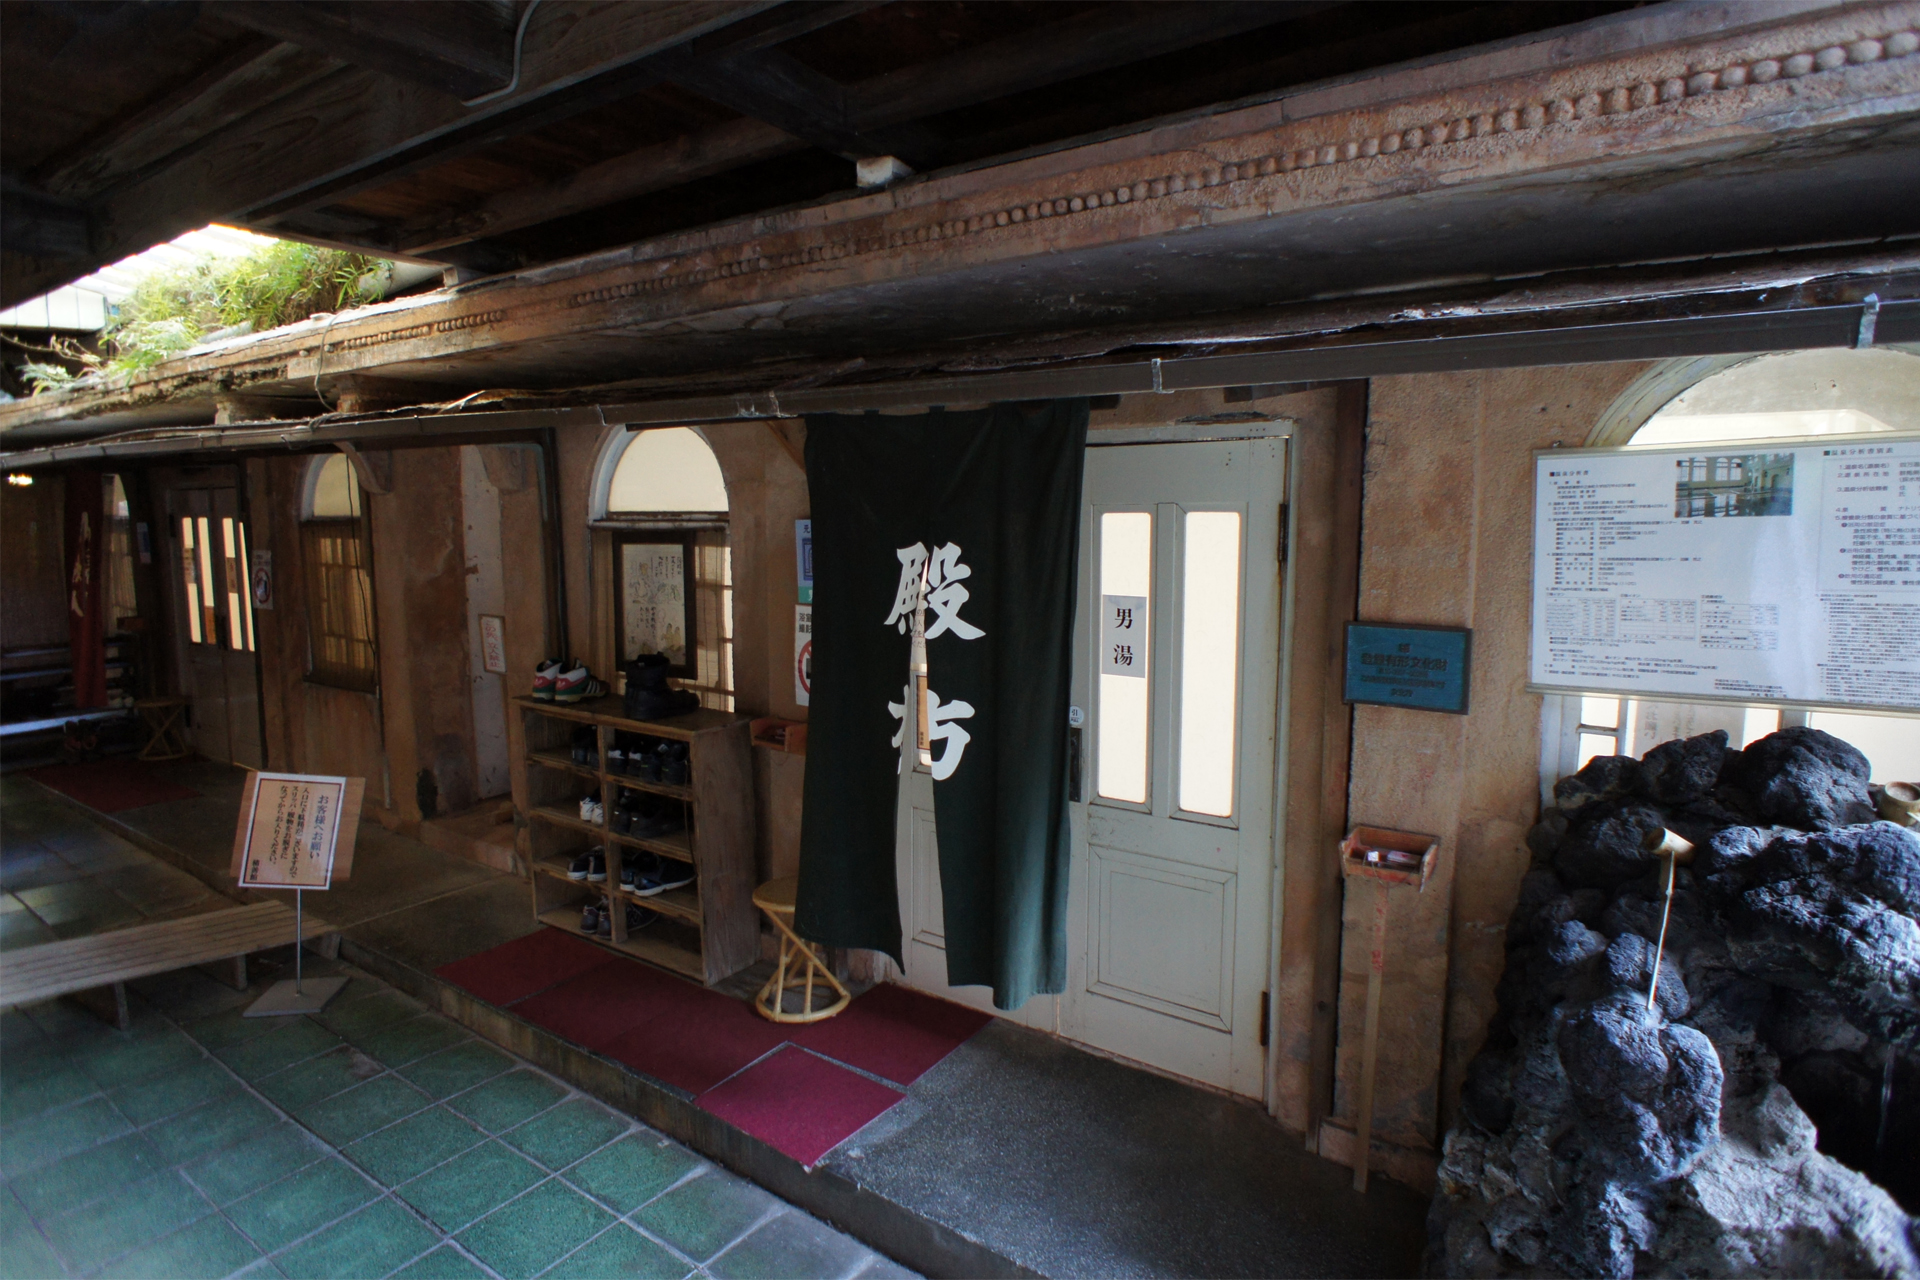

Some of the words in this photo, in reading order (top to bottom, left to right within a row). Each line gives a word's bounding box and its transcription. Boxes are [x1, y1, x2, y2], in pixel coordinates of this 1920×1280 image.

[1113, 608, 1134, 667] 男湯
[310, 794, 329, 860] お客様へお願い
